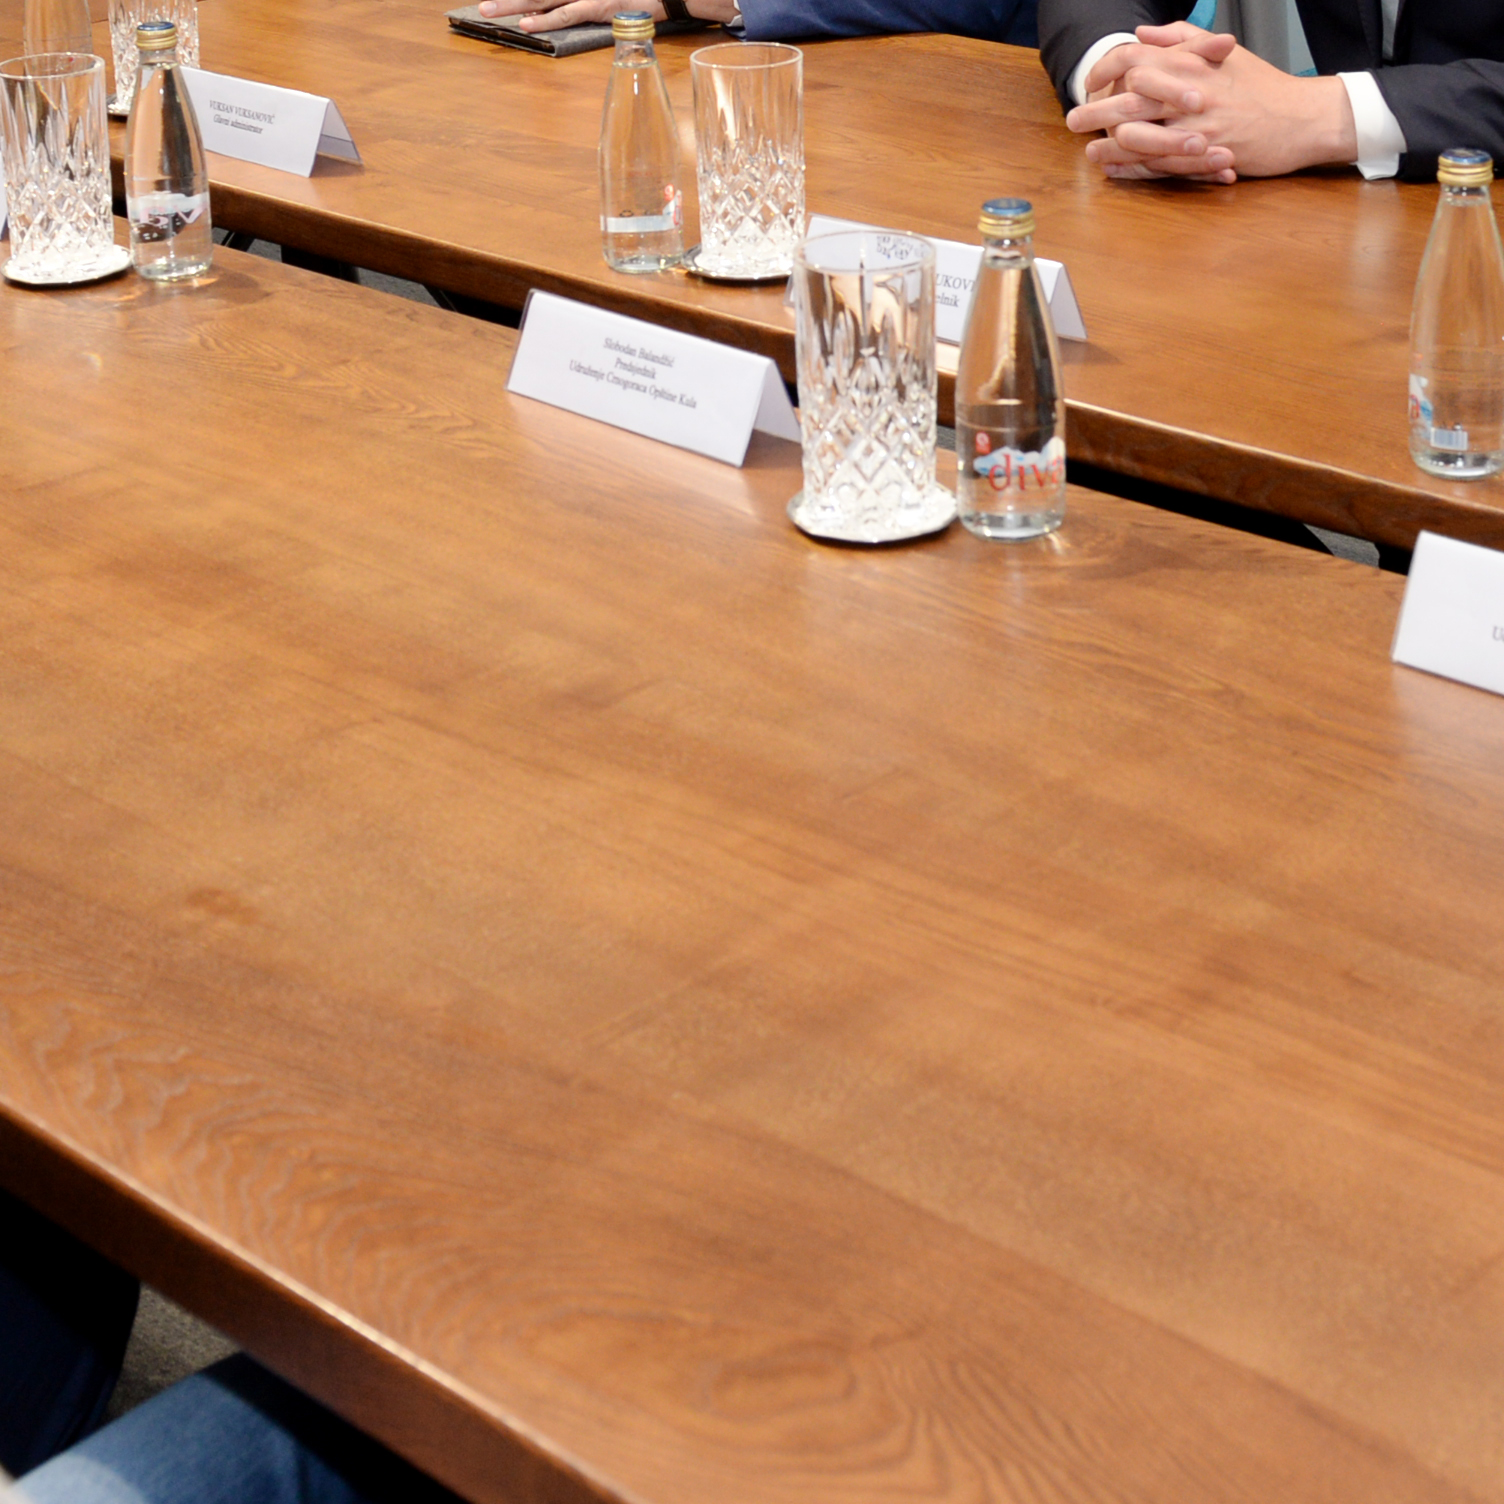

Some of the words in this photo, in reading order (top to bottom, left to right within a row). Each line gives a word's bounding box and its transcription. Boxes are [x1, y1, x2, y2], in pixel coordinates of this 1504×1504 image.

[936, 292, 959, 307] elnik
[603, 337, 636, 357] Slobodan
[606, 371, 646, 392] Crnogoraca
